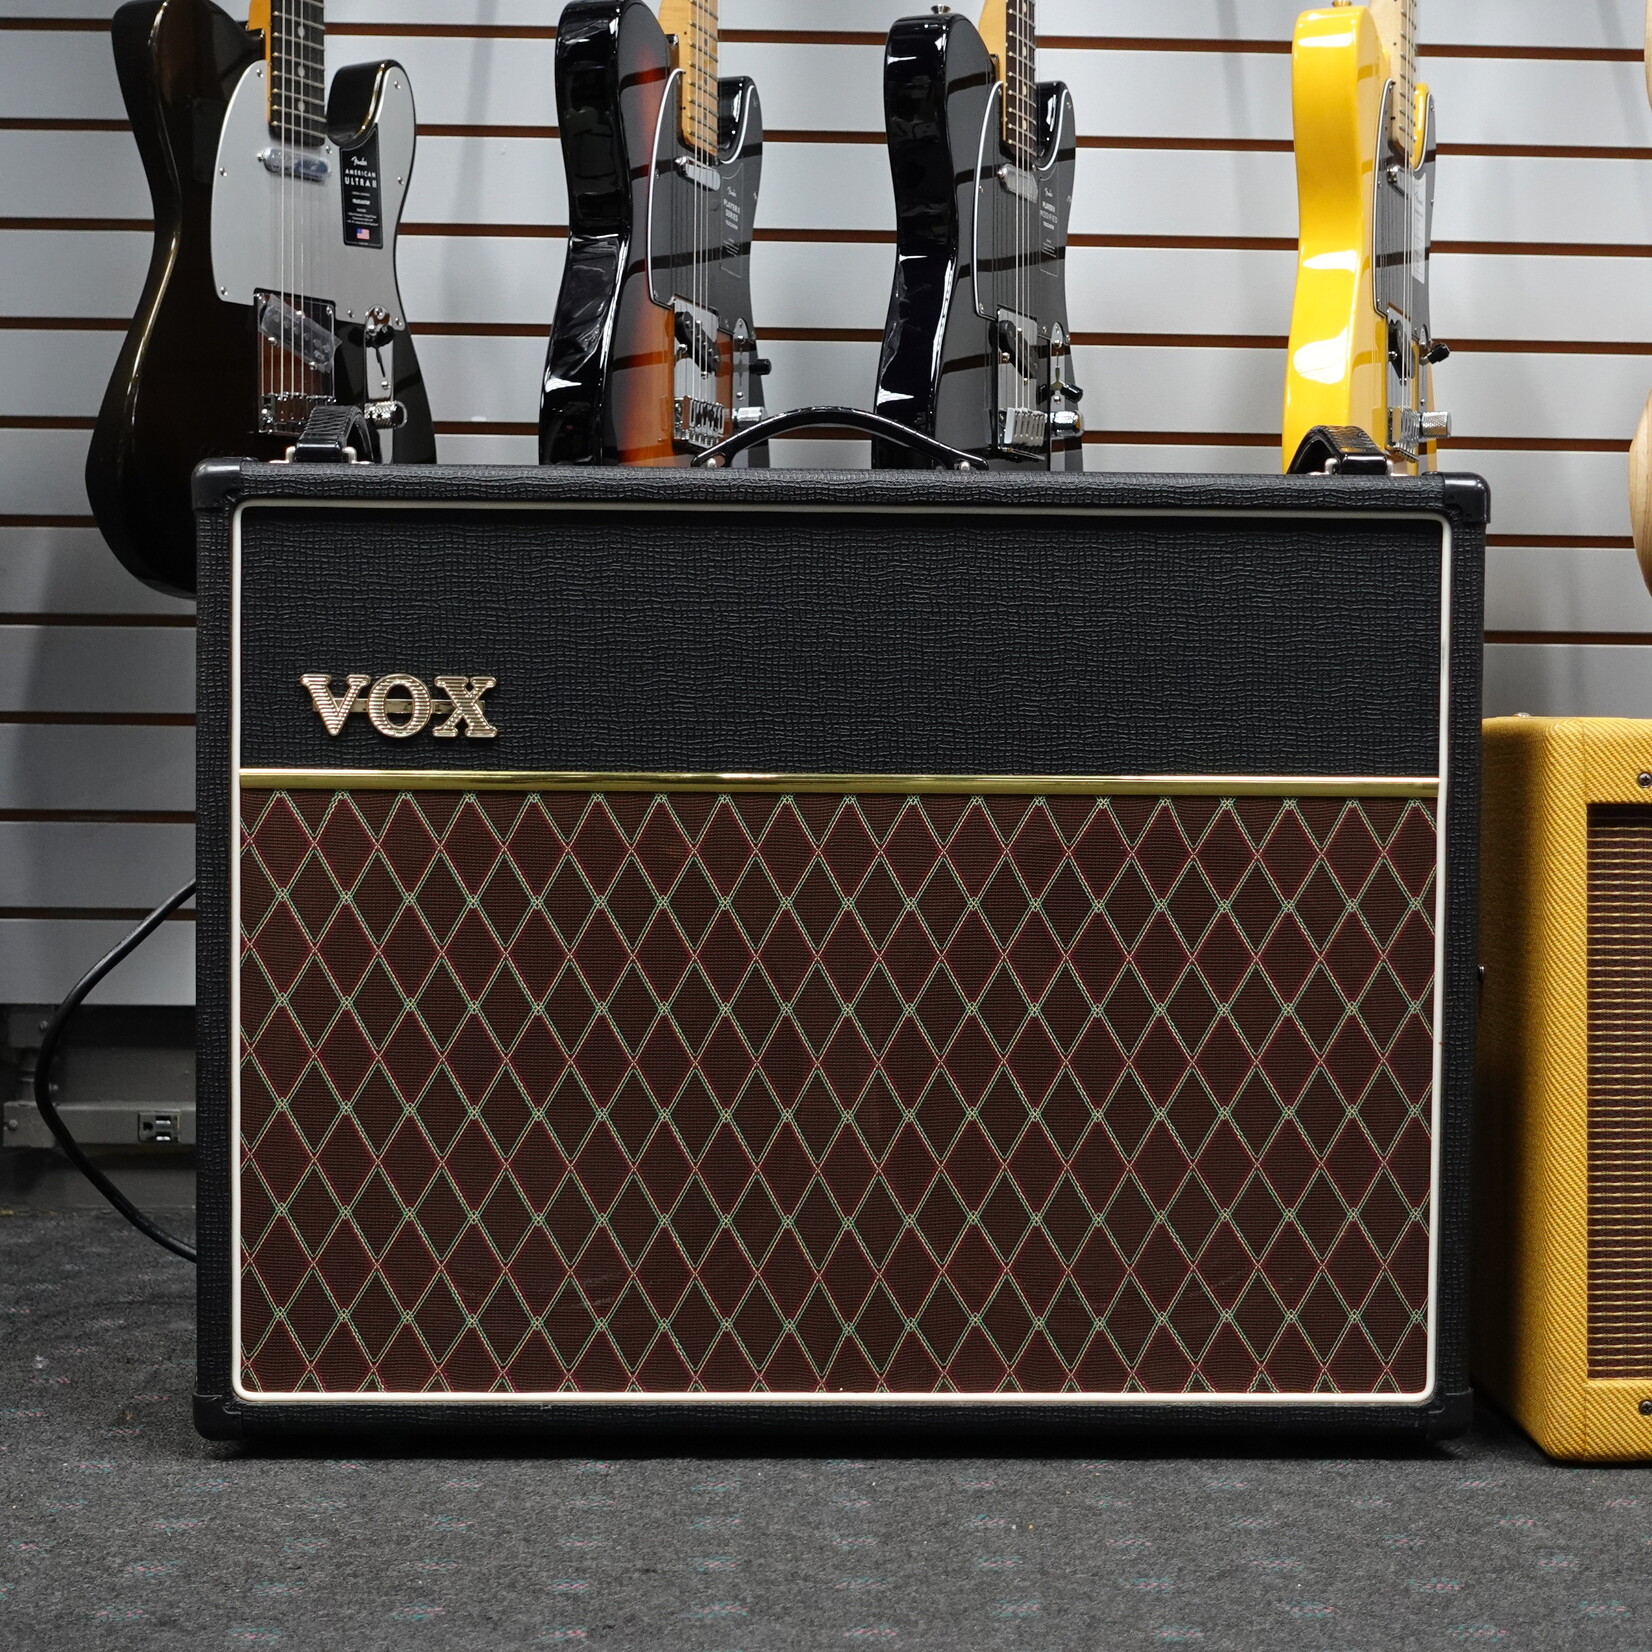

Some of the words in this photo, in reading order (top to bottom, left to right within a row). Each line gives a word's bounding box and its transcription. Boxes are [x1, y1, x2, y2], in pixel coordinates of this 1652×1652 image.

[345, 168, 376, 177] AMERICAN
[344, 177, 371, 187] ULTRA
[299, 673, 498, 739] VOX
